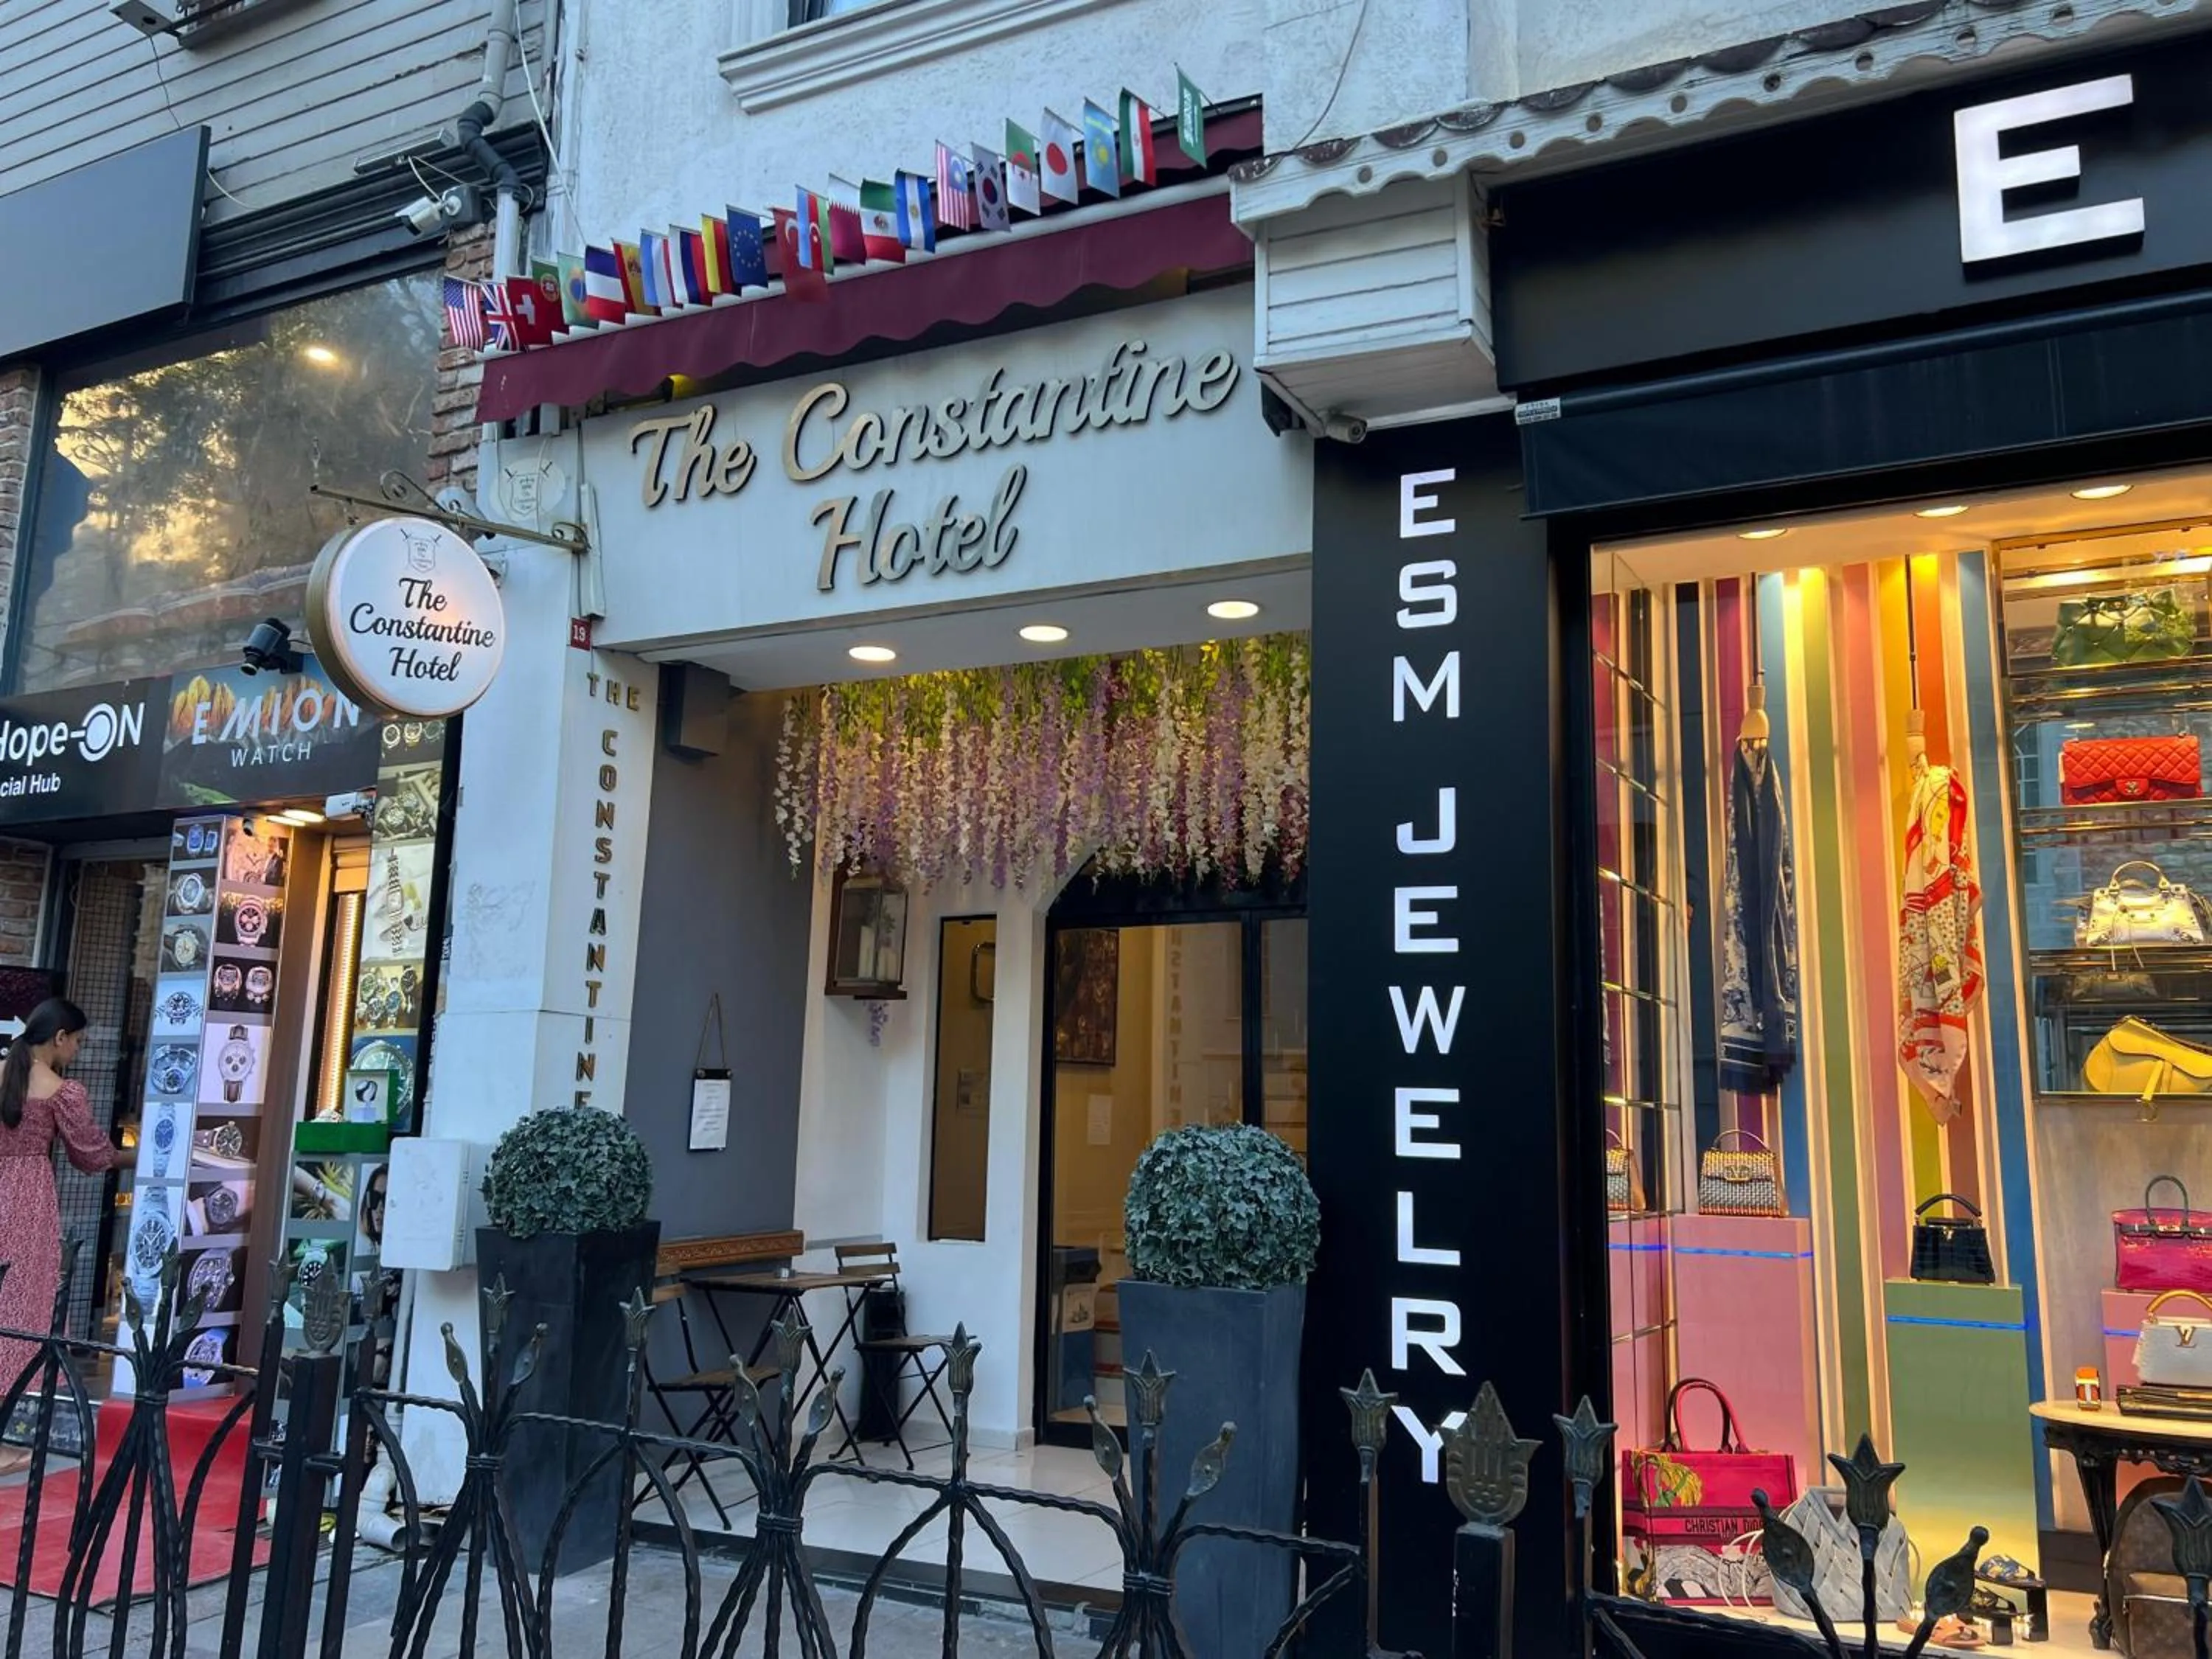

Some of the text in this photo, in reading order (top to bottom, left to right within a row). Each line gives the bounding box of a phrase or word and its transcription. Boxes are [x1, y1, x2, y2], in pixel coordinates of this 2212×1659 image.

[1954, 73, 2145, 263] E
[629, 339, 1241, 509] The Constantine
[810, 463, 1027, 591] Hotel
[399, 577, 447, 611] The
[349, 602, 495, 648] Constantine
[573, 625, 586, 642] 19
[389, 647, 462, 681] Hotel
[587, 672, 641, 712] THE
[231, 742, 312, 768] WATCH
[29, 772, 61, 794] Hub
[1388, 467, 1468, 1484] ESM JEWELRY
[1685, 1519, 1738, 1533] CHRISTIAN
